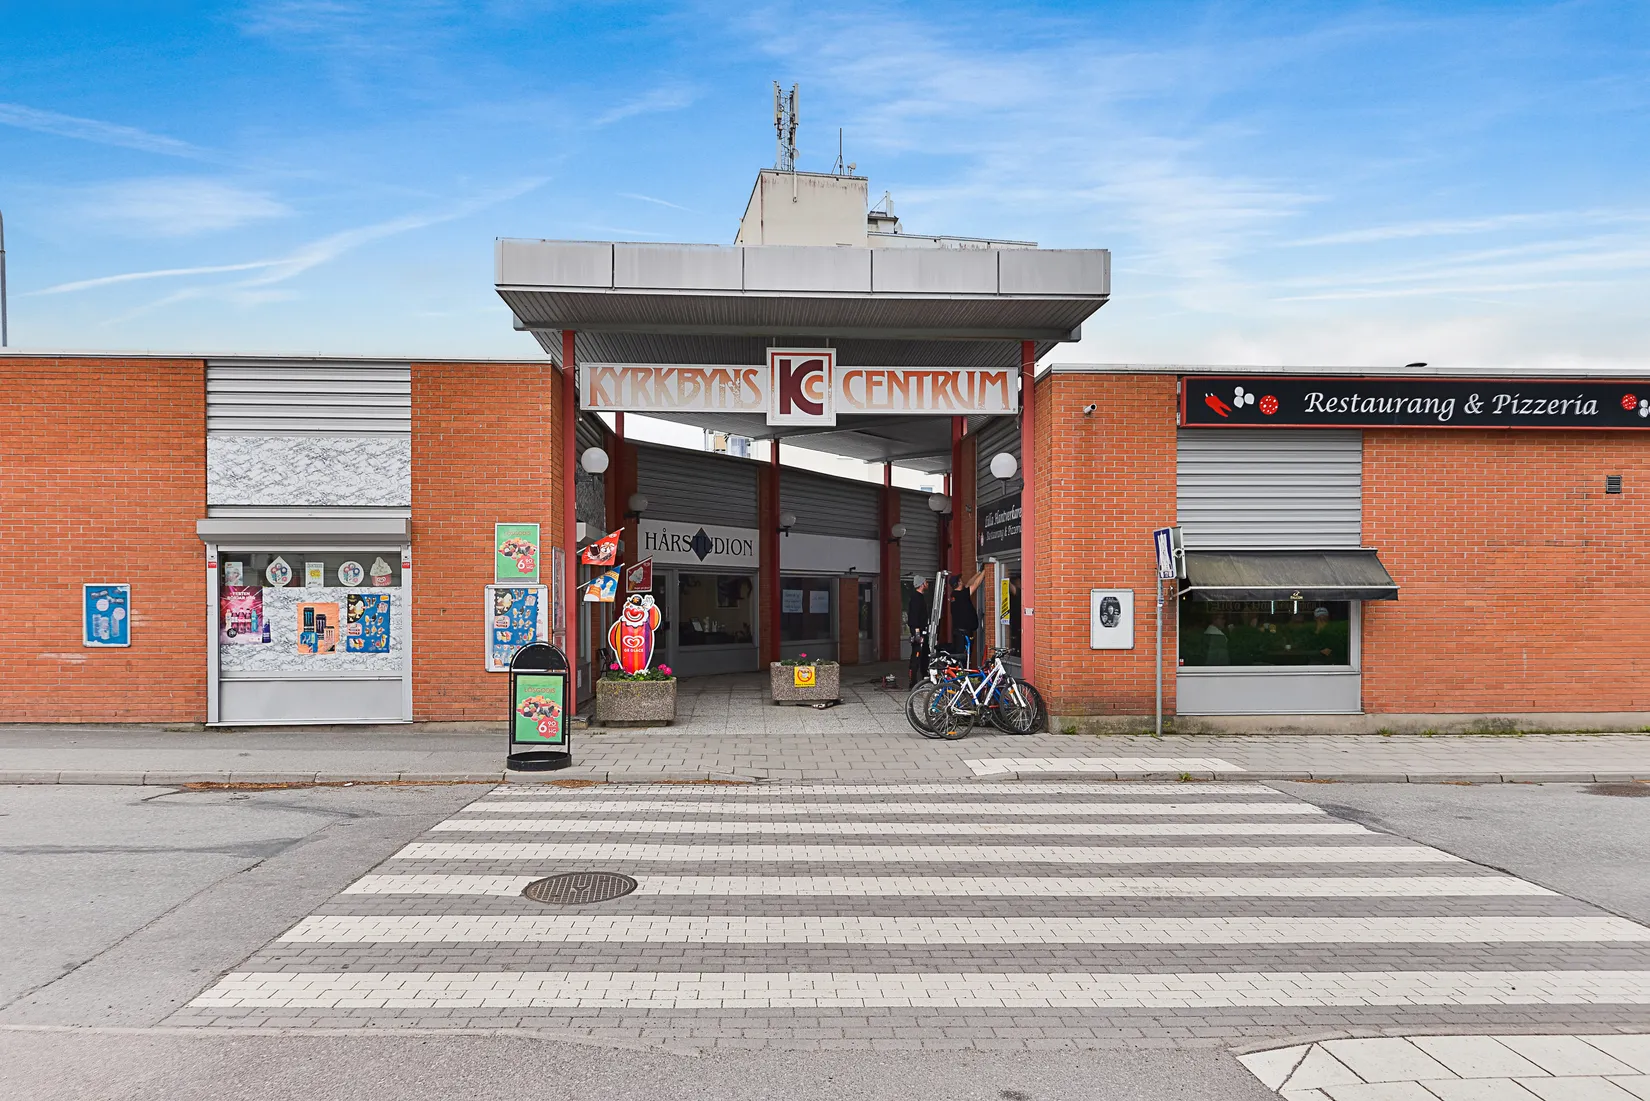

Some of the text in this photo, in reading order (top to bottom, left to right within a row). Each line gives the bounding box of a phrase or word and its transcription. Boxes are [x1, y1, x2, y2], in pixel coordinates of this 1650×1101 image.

[588, 366, 763, 409] KYRKBYNS
[842, 370, 1011, 410] CENTRUM
[1304, 392, 1599, 422] Restaurang & Pizzeria
[517, 560, 525, 569] 6
[538, 721, 548, 733] 6
